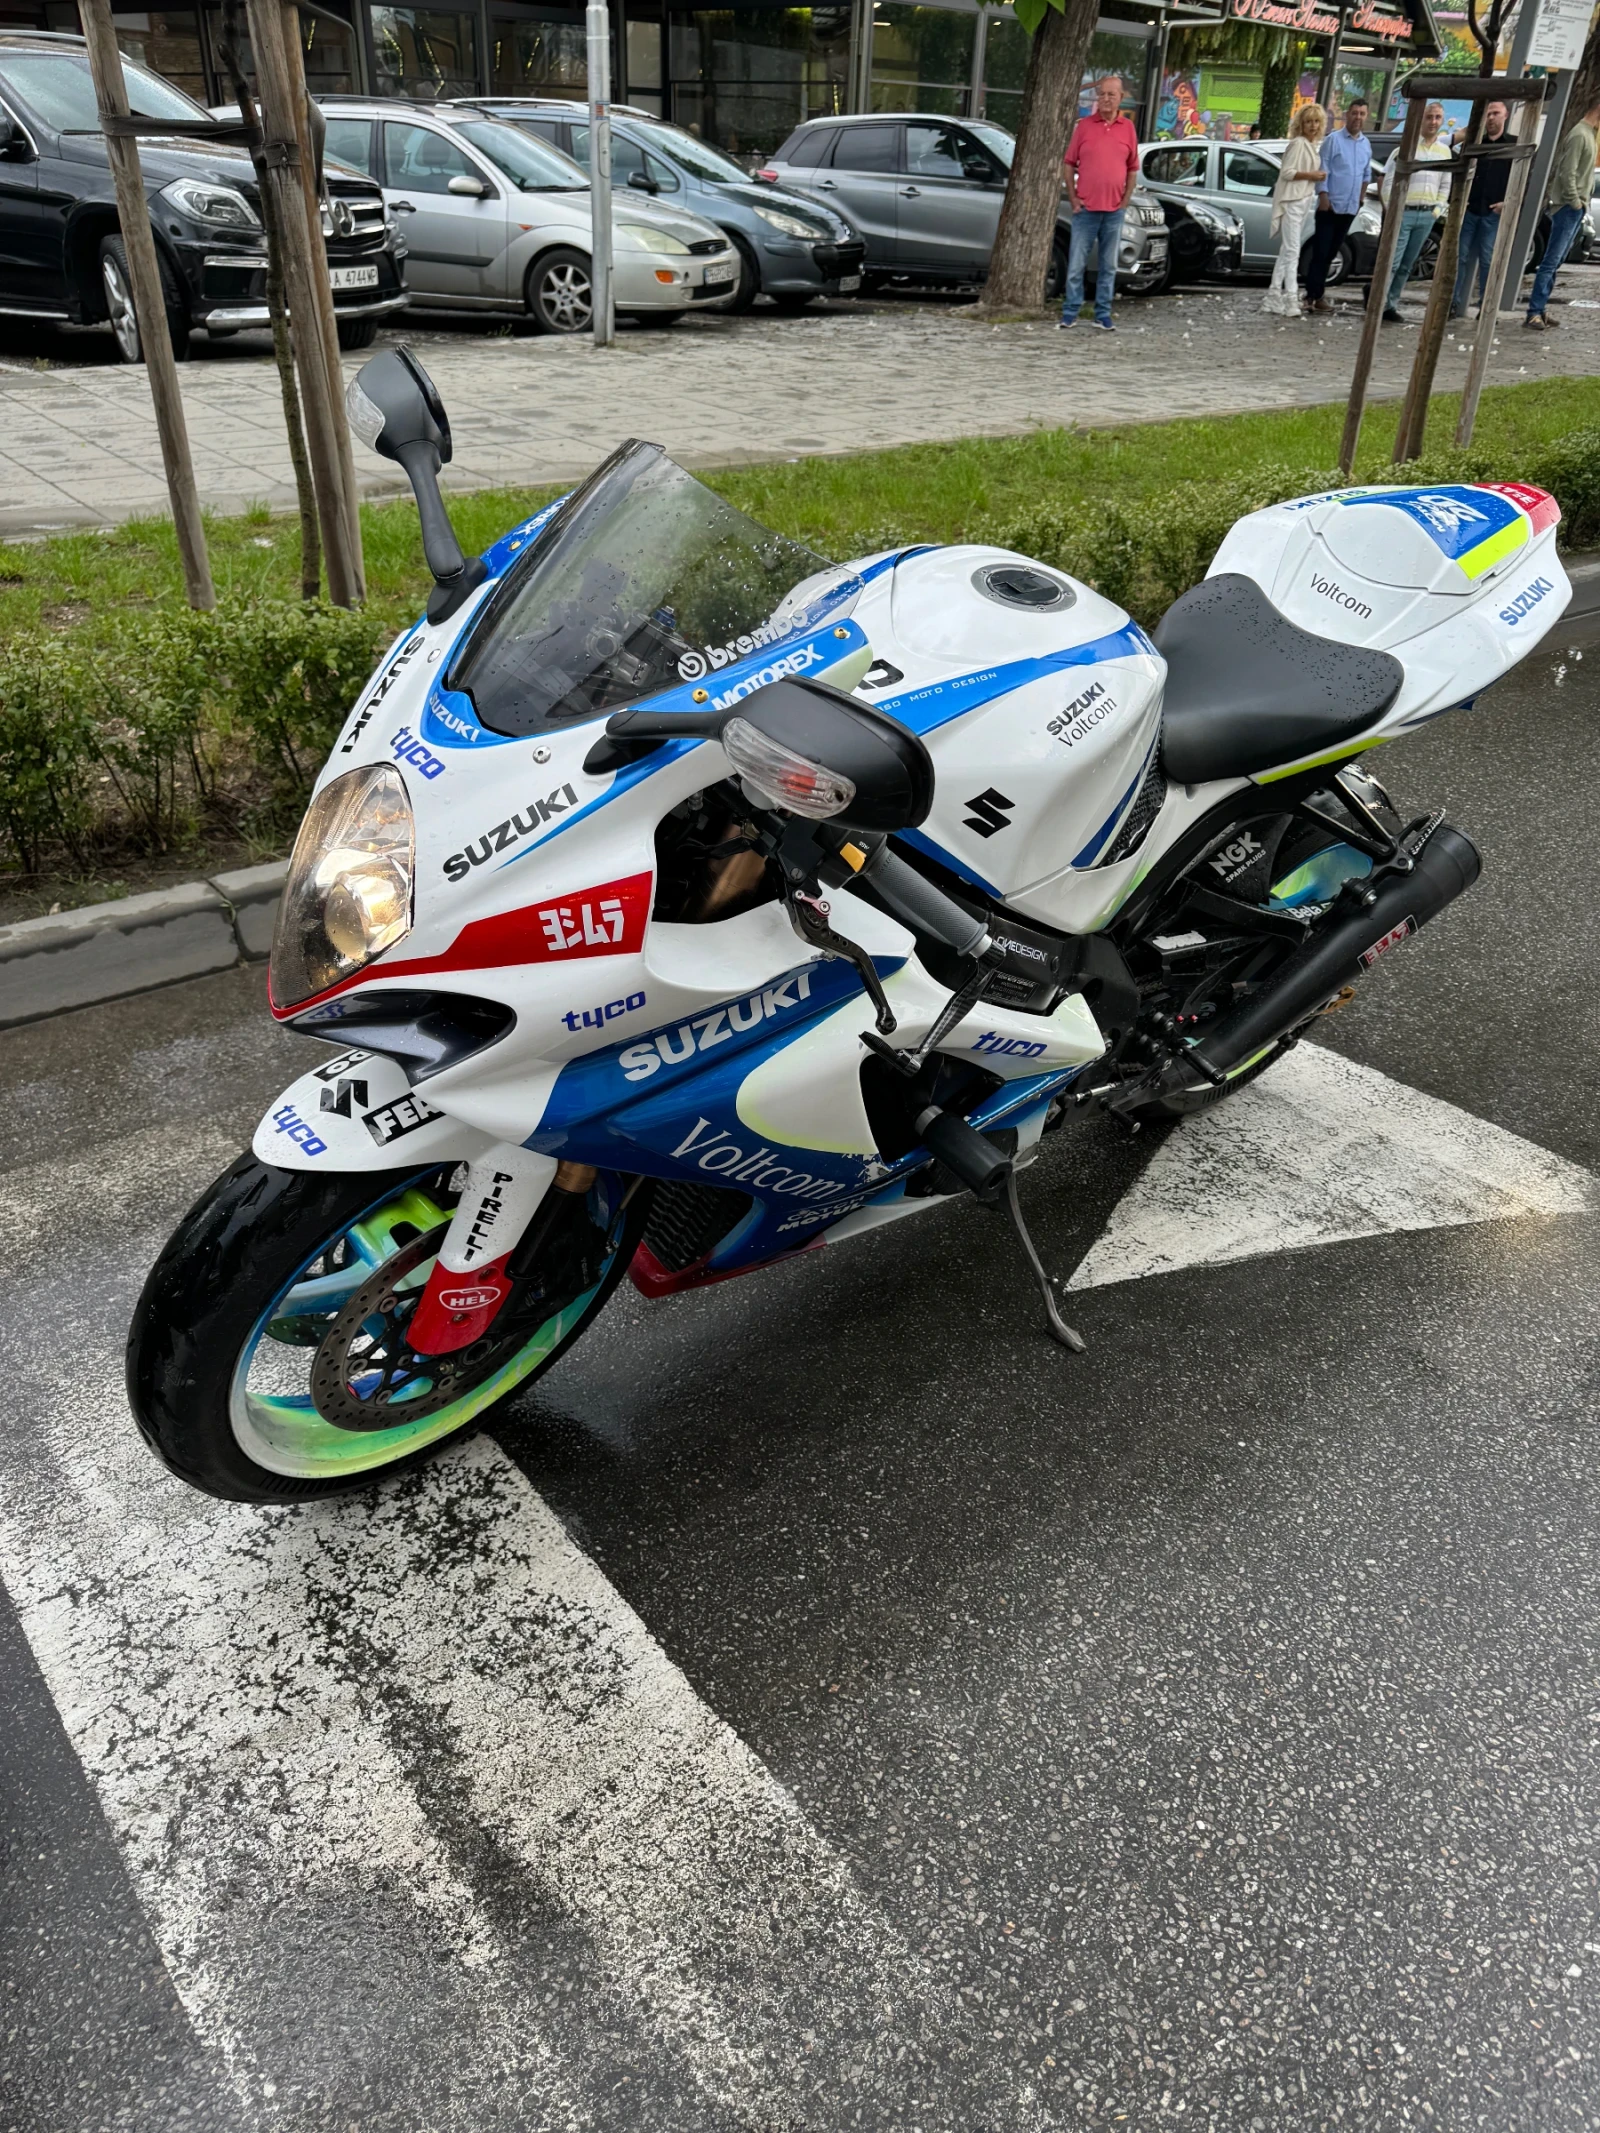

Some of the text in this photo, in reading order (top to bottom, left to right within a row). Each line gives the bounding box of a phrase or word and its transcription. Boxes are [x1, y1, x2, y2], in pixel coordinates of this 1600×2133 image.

[1310, 573, 1373, 619] Voltcom
[1499, 576, 1554, 626] SUZUKI
[704, 609, 808, 670] brembo
[340, 635, 425, 753] SUZUKI
[711, 643, 825, 711] MOTOREX
[909, 687, 943, 702] MOTO
[951, 672, 998, 689] DESIGN
[429, 692, 480, 743] SUZUKI
[1046, 681, 1106, 736] SUZUKI
[1058, 697, 1117, 747] Voltcom
[390, 726, 446, 780] tyco
[442, 783, 579, 882] SUZUKI
[1208, 831, 1262, 877] NGK
[1225, 848, 1266, 883] SPARK PLUGS
[538, 898, 625, 951] ヨシムラ
[561, 991, 646, 1032] tyco
[618, 972, 811, 1082] SUZUKI
[971, 1031, 1048, 1058] tyco
[272, 1104, 328, 1157] tyco
[669, 1116, 846, 1200] Voltcom
[463, 1171, 513, 1262] PIRELLI
[450, 1294, 490, 1308] HEL
